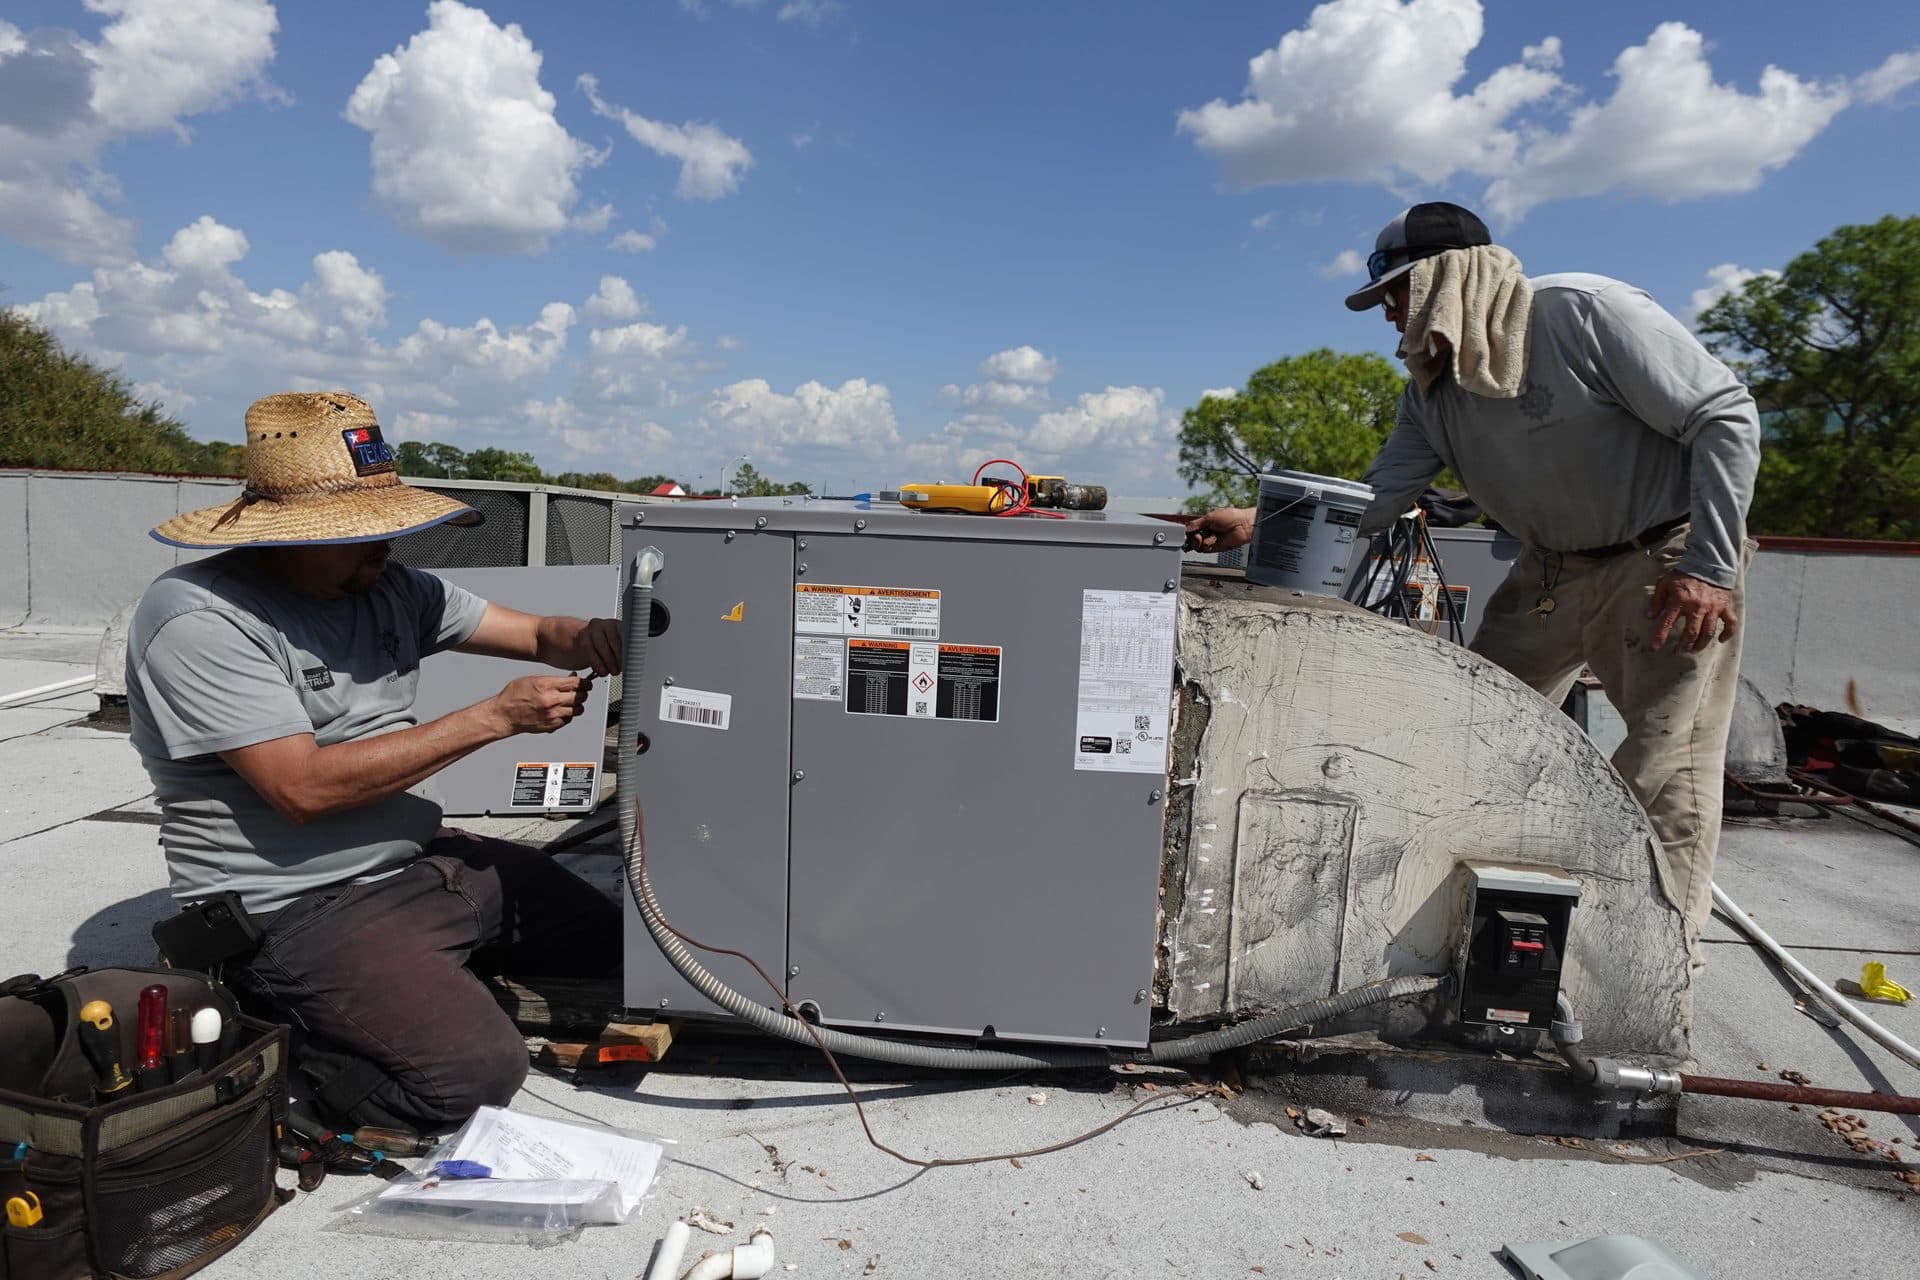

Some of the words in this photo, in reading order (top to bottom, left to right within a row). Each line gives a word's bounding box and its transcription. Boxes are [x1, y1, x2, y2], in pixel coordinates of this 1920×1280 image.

[811, 585, 843, 593] WARNING
[876, 589, 930, 598] AVERTISSEMENT
[946, 646, 999, 654] AVERTISSEMENT
